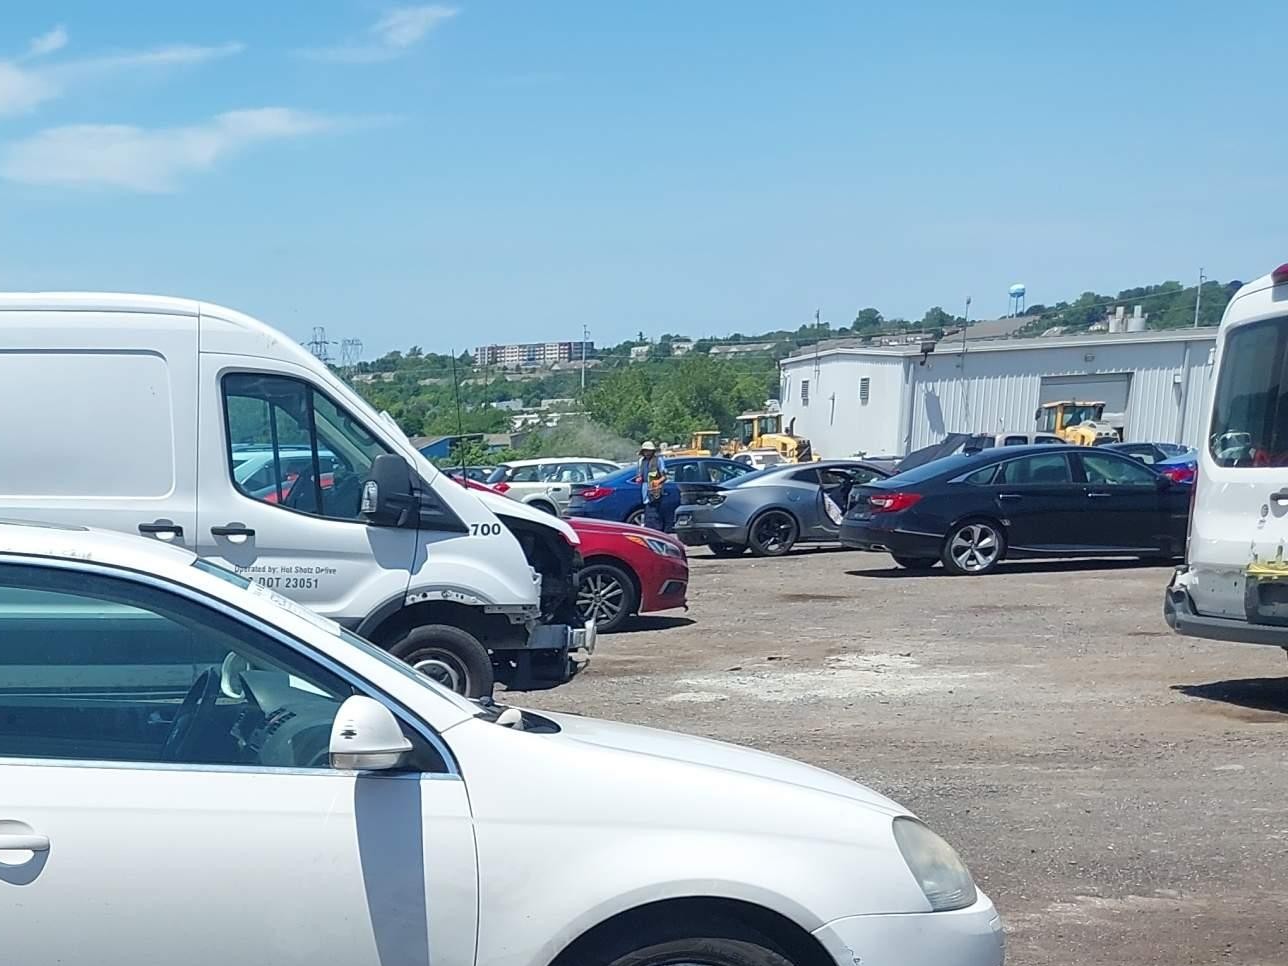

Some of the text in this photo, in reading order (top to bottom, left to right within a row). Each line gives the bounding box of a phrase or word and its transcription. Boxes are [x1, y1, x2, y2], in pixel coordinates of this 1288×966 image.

[471, 523, 501, 536] 700
[280, 566, 293, 574] Hot
[258, 577, 282, 588] DOT
[285, 577, 319, 589] 23051
